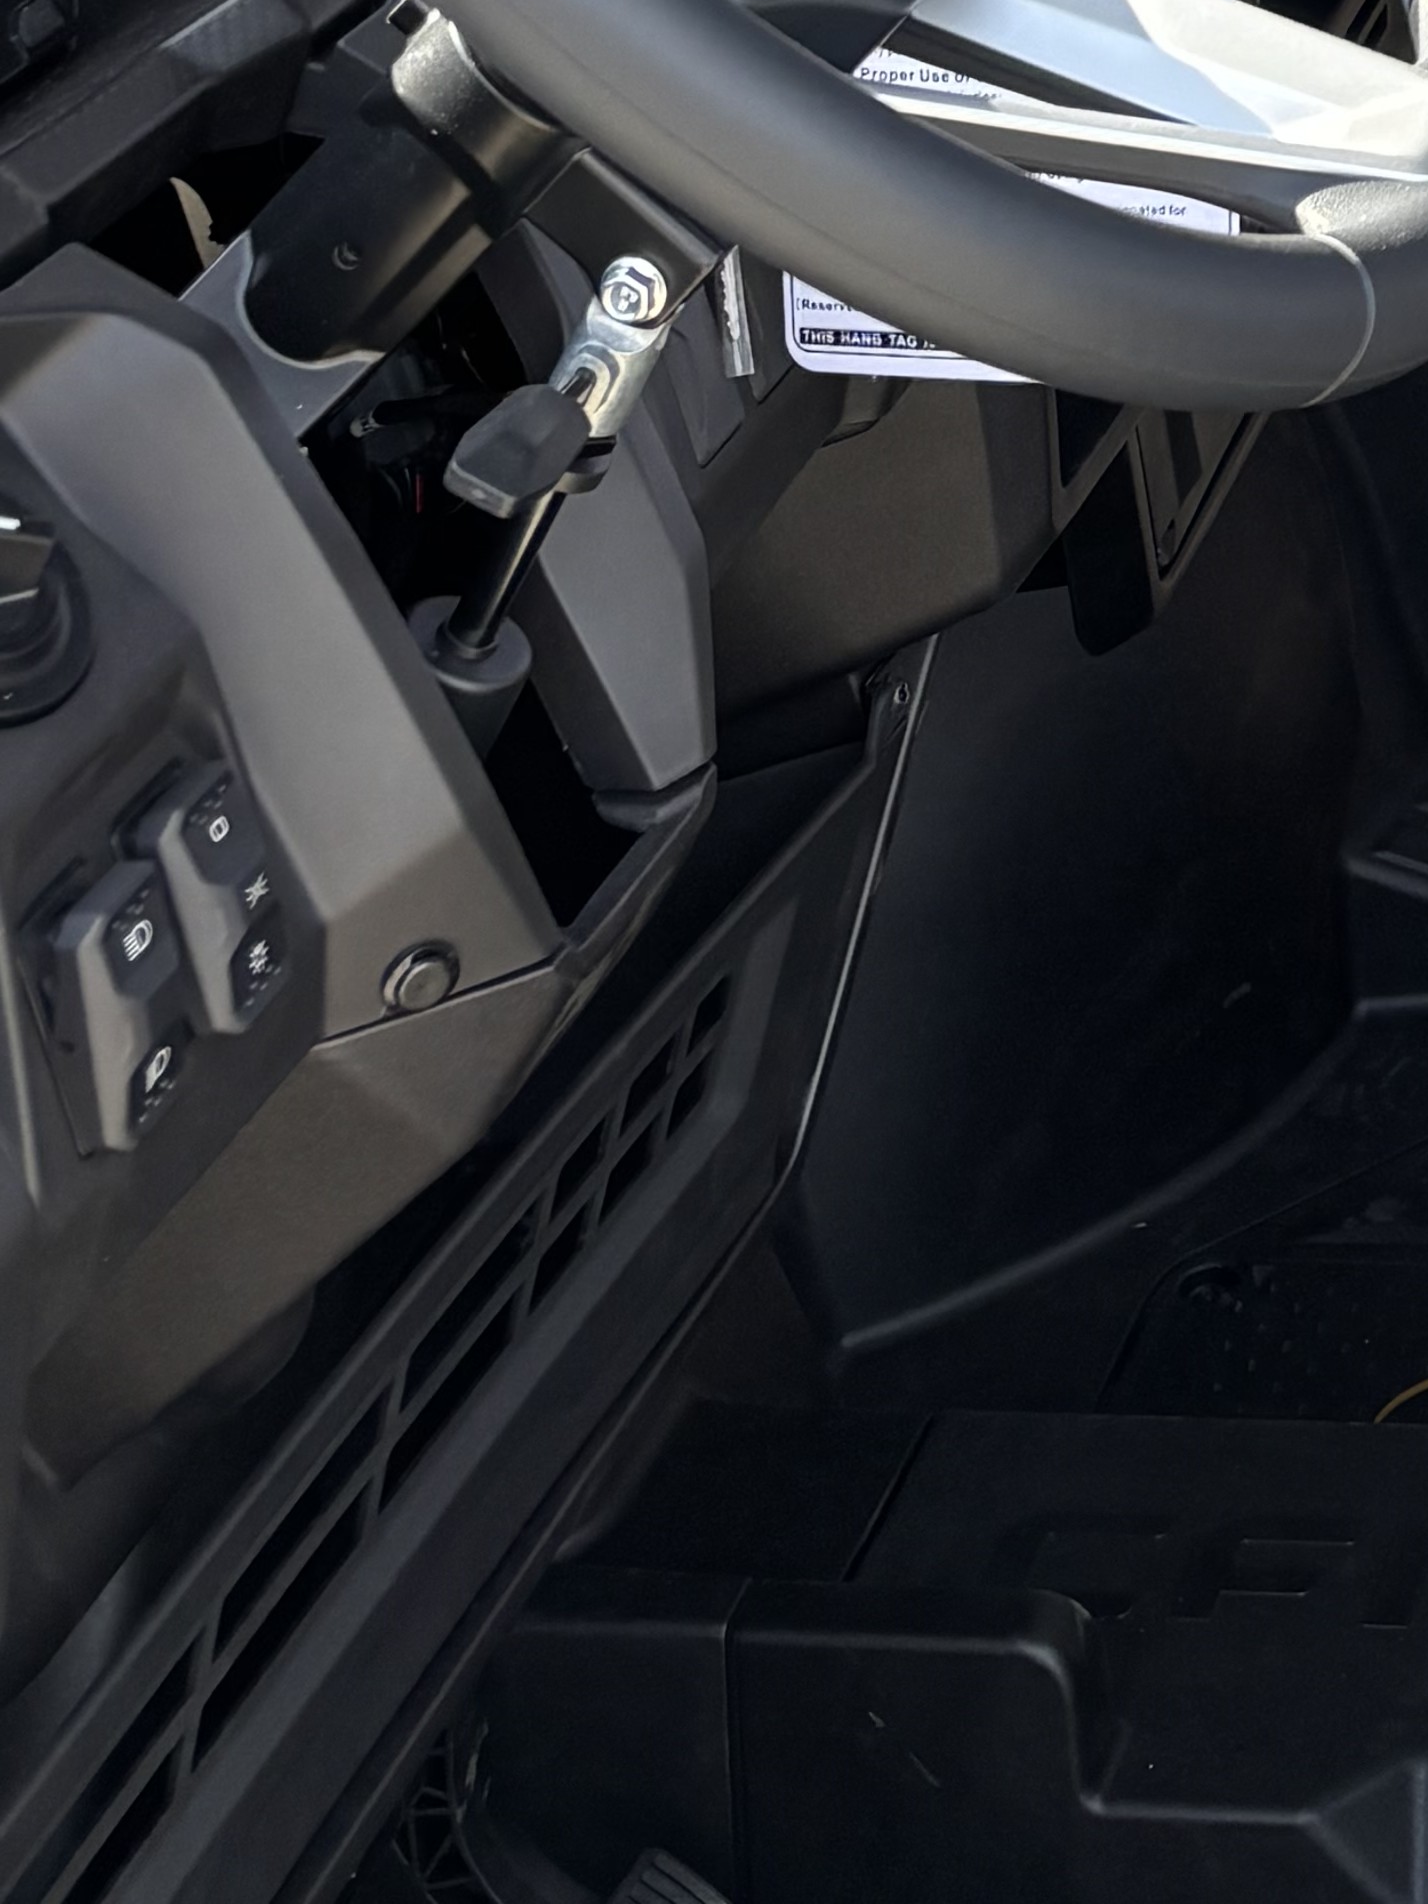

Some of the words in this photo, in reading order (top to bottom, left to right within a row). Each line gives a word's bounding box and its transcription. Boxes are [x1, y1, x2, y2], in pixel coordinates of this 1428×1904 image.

[860, 67, 914, 84] Proper
[920, 69, 949, 83] Use
[1169, 204, 1187, 216] for
[801, 330, 835, 344] THIS
[888, 334, 918, 348] TAG
